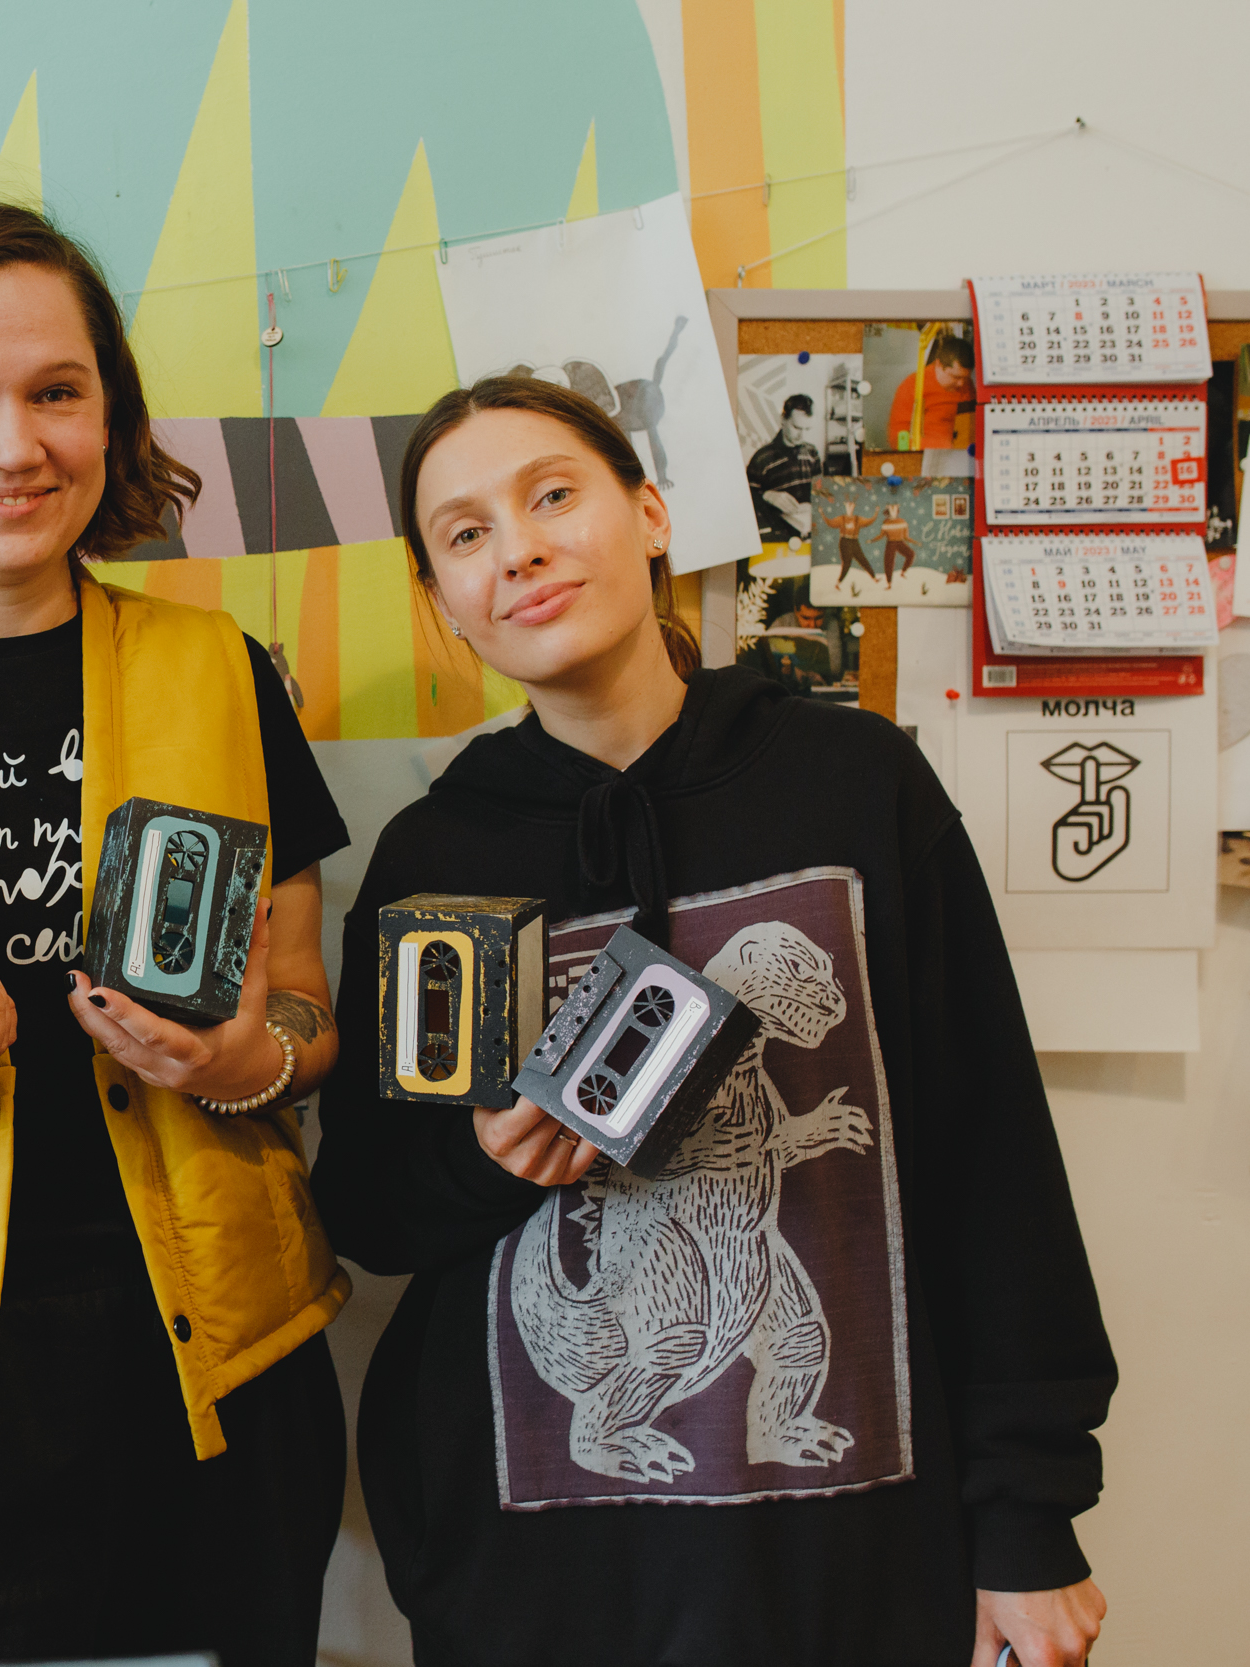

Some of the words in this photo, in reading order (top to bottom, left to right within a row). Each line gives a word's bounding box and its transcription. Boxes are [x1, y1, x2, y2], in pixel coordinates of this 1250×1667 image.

[1021, 281, 1057, 289] МАРТ
[1068, 280, 1096, 288] 2023
[1107, 279, 1154, 287] MARCH
[1075, 298, 1080, 307] 1
[1101, 298, 1108, 306] 2
[1128, 297, 1135, 306] 3
[1154, 297, 1161, 306] 4
[1180, 296, 1188, 305] 5
[1021, 313, 1029, 321] 6
[1049, 312, 1056, 321] 7
[1075, 312, 1083, 321] 8
[1101, 311, 1110, 320] 9
[1125, 311, 1140, 320] 10
[1152, 311, 1164, 320] 11
[1178, 310, 1192, 320] 12
[1019, 327, 1034, 336] 13
[1046, 327, 1061, 335] 14
[1073, 326, 1087, 335] 15
[1100, 325, 1114, 334] 16
[1127, 325, 1140, 334] 17
[1152, 325, 1167, 334] 18
[1179, 324, 1194, 333] 19
[1019, 341, 1037, 350] 20
[1047, 340, 1061, 350] 21
[1073, 340, 1089, 349] 22
[1100, 339, 1116, 349] 23
[1126, 339, 1143, 348] 24
[1152, 339, 1170, 348] 25
[1180, 338, 1197, 347] 26
[1021, 355, 1037, 364] 27
[1047, 355, 1064, 364] 28
[1074, 354, 1091, 363] 29
[1101, 354, 1118, 363] 30
[1129, 353, 1142, 363] 31
[1029, 417, 1080, 426] АПРЕЛЬ
[1090, 416, 1118, 425] 2023
[1129, 416, 1164, 425] APRIL
[1159, 436, 1164, 446] 1
[1183, 435, 1191, 446] 2
[1028, 453, 1035, 462] 3
[1054, 453, 1062, 461] 4
[1080, 452, 1088, 461] 5
[1106, 452, 1114, 461] 6
[1133, 451, 1140, 461] 7
[1157, 451, 1165, 460] 8
[1024, 467, 1039, 477] 10
[1052, 467, 1063, 476] 11
[1077, 466, 1091, 476] 12
[1104, 466, 1117, 475] 13
[1129, 466, 1143, 475] 14
[1154, 465, 1169, 475] 15
[1179, 466, 1193, 475] 16
[1025, 482, 1038, 492] 17
[1051, 482, 1065, 491] 18
[1078, 481, 1092, 490] 19
[1102, 481, 1119, 490] 20
[1129, 480, 1142, 490] 21
[1153, 480, 1170, 490] 22
[1024, 497, 1040, 506] 24
[1050, 496, 1066, 506] 25
[1076, 496, 1093, 505] 26
[1103, 495, 1118, 505] 27
[1128, 495, 1144, 505] 28
[1153, 495, 1169, 505] 29
[1179, 494, 1196, 504] 30
[922, 521, 934, 542] С
[1044, 546, 1072, 556] МАЙ
[1083, 547, 1110, 555] 2023
[1121, 546, 1147, 555] MAY
[1031, 567, 1036, 576] 1
[1056, 567, 1063, 575] 2
[1082, 566, 1090, 575] 3
[1108, 566, 1116, 574] 4
[1134, 565, 1142, 574] 5
[1160, 564, 1168, 573] 6
[1187, 563, 1194, 573] 7
[1032, 581, 1040, 589] 8
[1058, 580, 1066, 589] 9
[1081, 580, 1096, 588] 10
[1109, 579, 1120, 588] 11
[1133, 578, 1147, 587] 12
[1159, 578, 1174, 587] 13
[1185, 578, 1200, 587] 14
[1031, 594, 1046, 603] 15
[1057, 594, 1072, 603] 16
[1084, 593, 1097, 602] 17
[1109, 593, 1124, 602] 18
[1135, 593, 1150, 601] 19
[1160, 592, 1177, 601] 20
[1187, 591, 1201, 601] 21
[1033, 608, 1049, 616] 22
[1058, 608, 1075, 617] 23
[1084, 608, 1101, 616] 24
[1110, 607, 1127, 616] 25
[1136, 606, 1153, 615] 26
[1162, 605, 1179, 615] 27
[1188, 605, 1205, 615] 28
[1036, 621, 1052, 630] 29
[1061, 622, 1078, 630] 30
[1088, 621, 1102, 630] 31
[1042, 699, 1135, 717] молча
